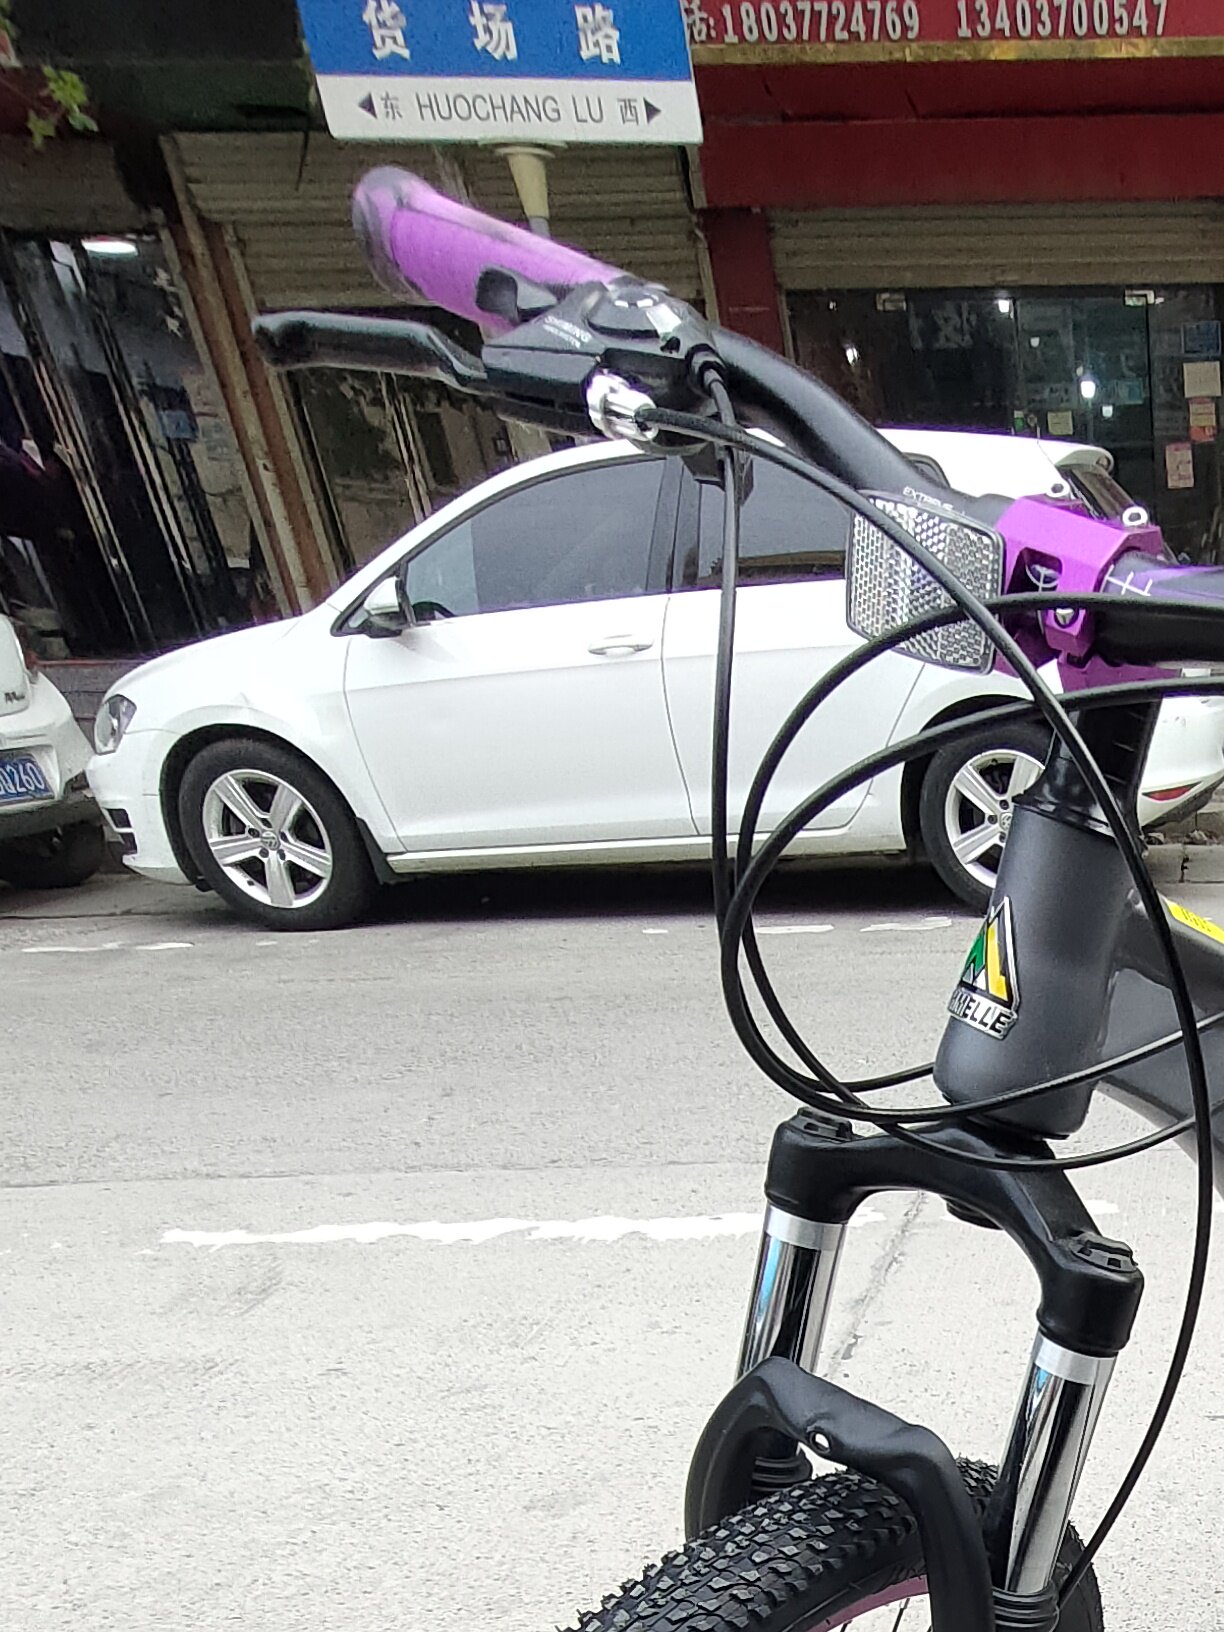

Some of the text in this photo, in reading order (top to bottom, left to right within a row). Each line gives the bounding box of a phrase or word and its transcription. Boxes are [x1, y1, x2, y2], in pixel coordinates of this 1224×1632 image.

[362, 0, 620, 63] 货场路
[957, 0, 1167, 39] 13403700547
[381, 93, 639, 126] 东 HUOCHANG LU 西
